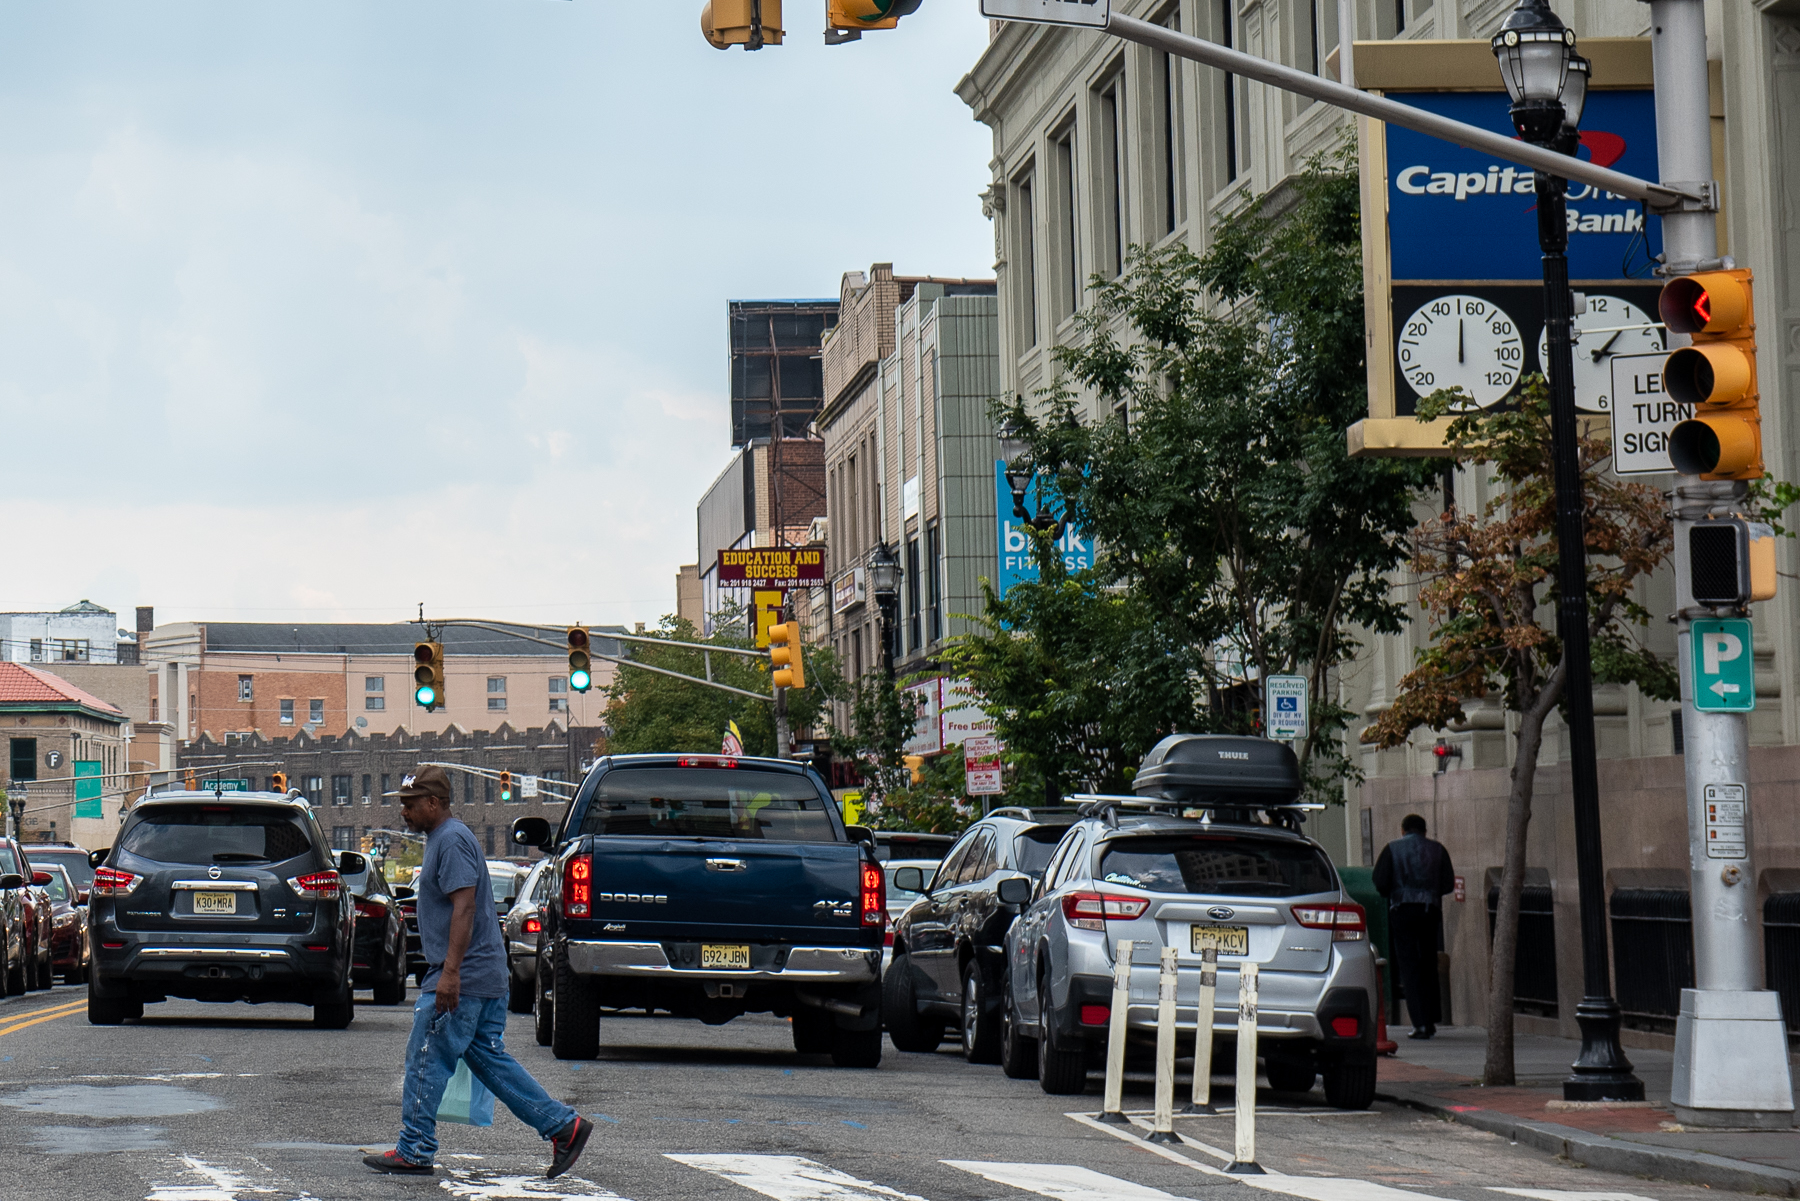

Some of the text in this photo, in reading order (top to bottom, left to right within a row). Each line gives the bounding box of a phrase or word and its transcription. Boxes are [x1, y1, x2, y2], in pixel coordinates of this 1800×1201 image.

[1396, 165, 1538, 200] Capita
[1565, 209, 1645, 233] Bank
[1431, 302, 1450, 317] 40
[1465, 302, 1485, 316] 60
[1589, 298, 1608, 313] 12
[1408, 323, 1427, 337] 20
[1492, 321, 1512, 335] 80
[1401, 349, 1411, 362] 0
[1496, 347, 1521, 362] 100
[1409, 372, 1435, 386] -20
[1485, 372, 1513, 386] 120
[1633, 374, 1666, 395] LE
[1598, 395, 1608, 409] 6
[1623, 431, 1672, 454] SIGN
[722, 551, 820, 566] EDUCATION AND
[1005, 556, 1088, 571] FITSS
[745, 565, 798, 579] SUCCESS
[720, 579, 730, 587] Ph:
[730, 579, 740, 587] 201
[741, 579, 752, 587] 918
[753, 579, 767, 587] 2427
[774, 579, 787, 587] Fax:
[787, 579, 798, 587] 201
[798, 579, 809, 587] 918
[1702, 632, 1743, 675] P
[948, 721, 969, 731] Free
[971, 722, 997, 731] Deliv
[50, 754, 59, 767] F
[1218, 751, 1249, 760] THULE
[204, 781, 239, 792] Academy
[196, 897, 233, 909] K30 MRA
[600, 892, 668, 904] DODGE
[1223, 933, 1244, 949] KCV
[703, 949, 748, 964] G92 JBN
